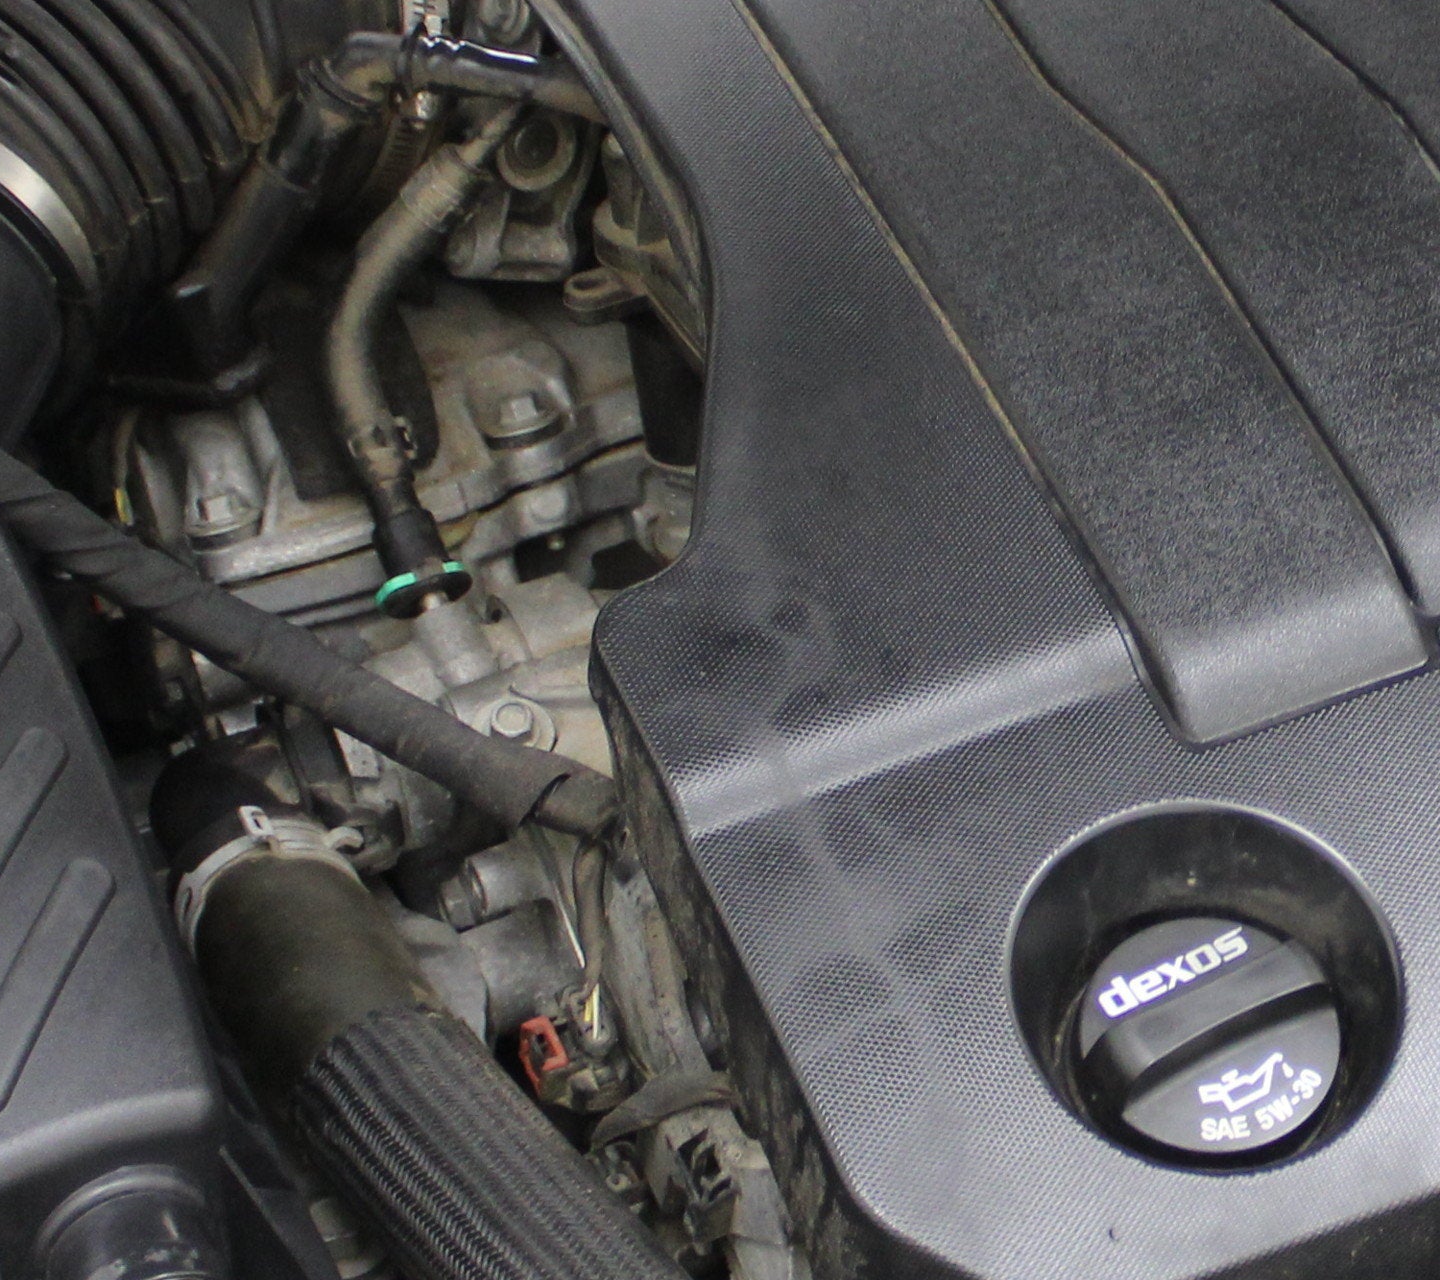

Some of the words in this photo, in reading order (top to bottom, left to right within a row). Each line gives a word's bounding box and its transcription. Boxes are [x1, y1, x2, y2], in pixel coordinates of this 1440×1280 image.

[1097, 926, 1249, 1018] dexos
[1200, 1116, 1251, 1141] SAE
[1255, 1068, 1322, 1130] 5W-30
